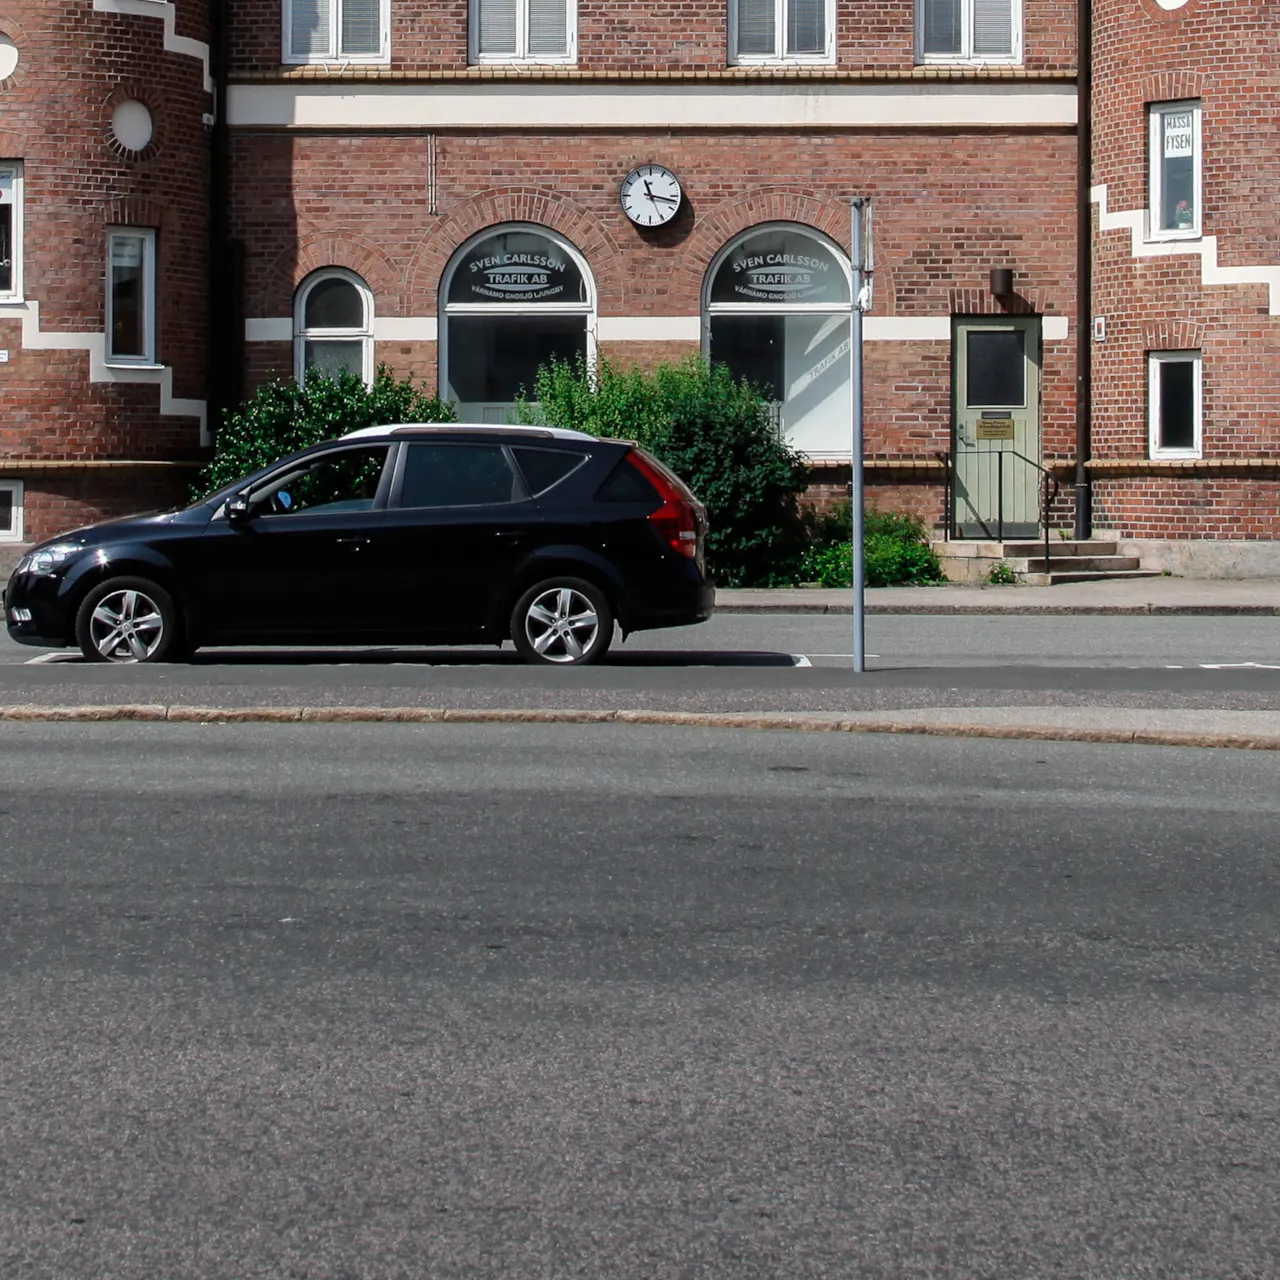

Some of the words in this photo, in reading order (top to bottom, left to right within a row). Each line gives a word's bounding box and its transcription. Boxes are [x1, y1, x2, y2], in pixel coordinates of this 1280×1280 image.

[1166, 115, 1191, 130] MASSA
[1166, 133, 1191, 150] FYSEN
[469, 255, 500, 273] SVEN
[503, 254, 566, 273] CARLSSON
[732, 255, 764, 273] SVEN
[766, 254, 829, 272] CARLSSON
[487, 274, 529, 283] TRAFIK
[531, 274, 548, 283] AB
[751, 274, 792, 284] TRAFIK
[794, 274, 811, 283] AB
